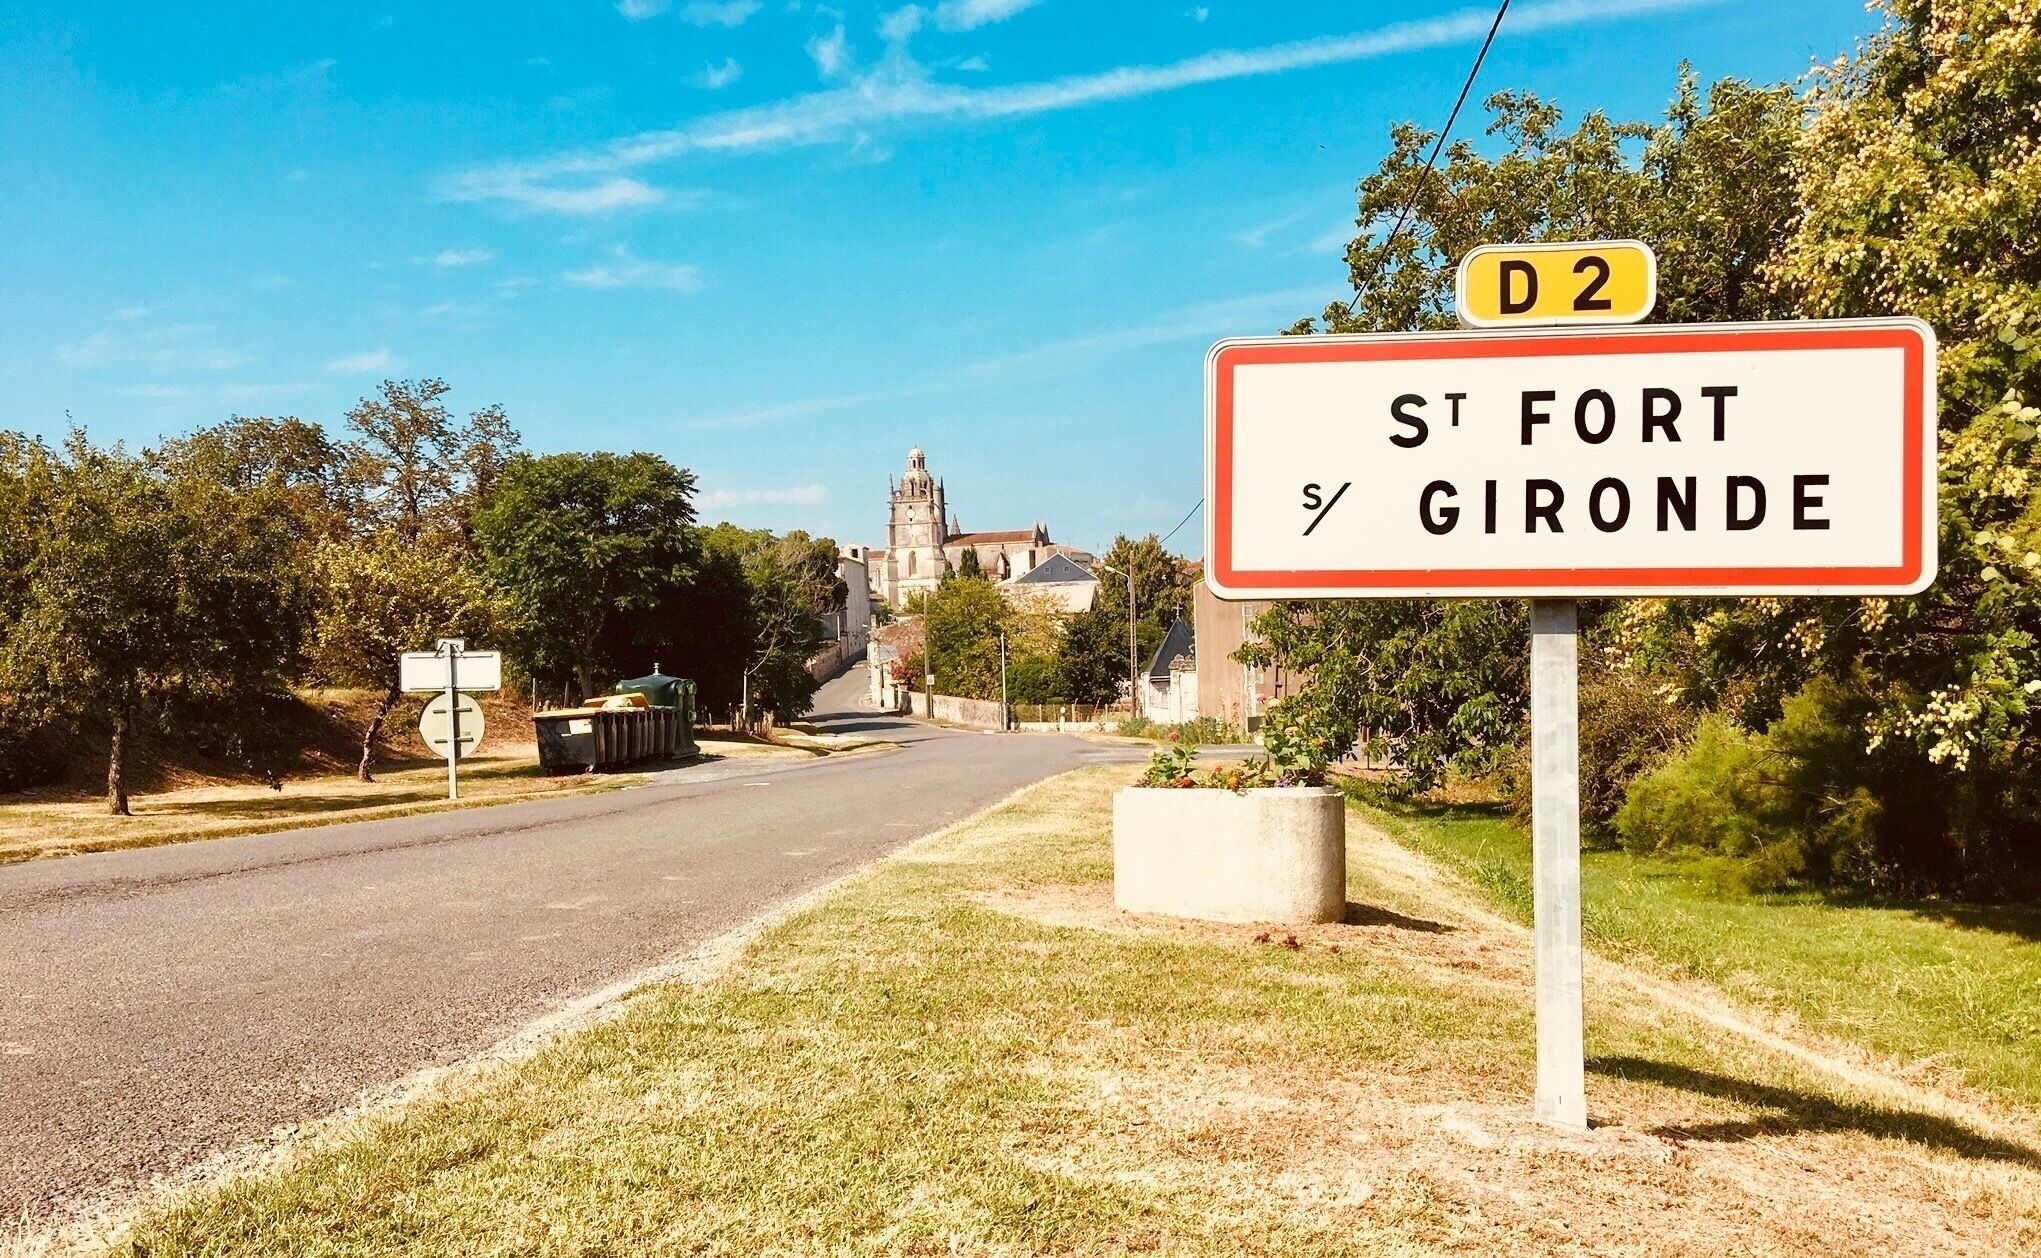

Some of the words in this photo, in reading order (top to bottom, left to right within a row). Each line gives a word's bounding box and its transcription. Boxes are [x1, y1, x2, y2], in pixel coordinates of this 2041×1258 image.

[1500, 259, 1539, 315] D
[1573, 255, 1612, 312] 2
[1520, 385, 1739, 446] FORT
[1419, 474, 1830, 536] GIRONDE
